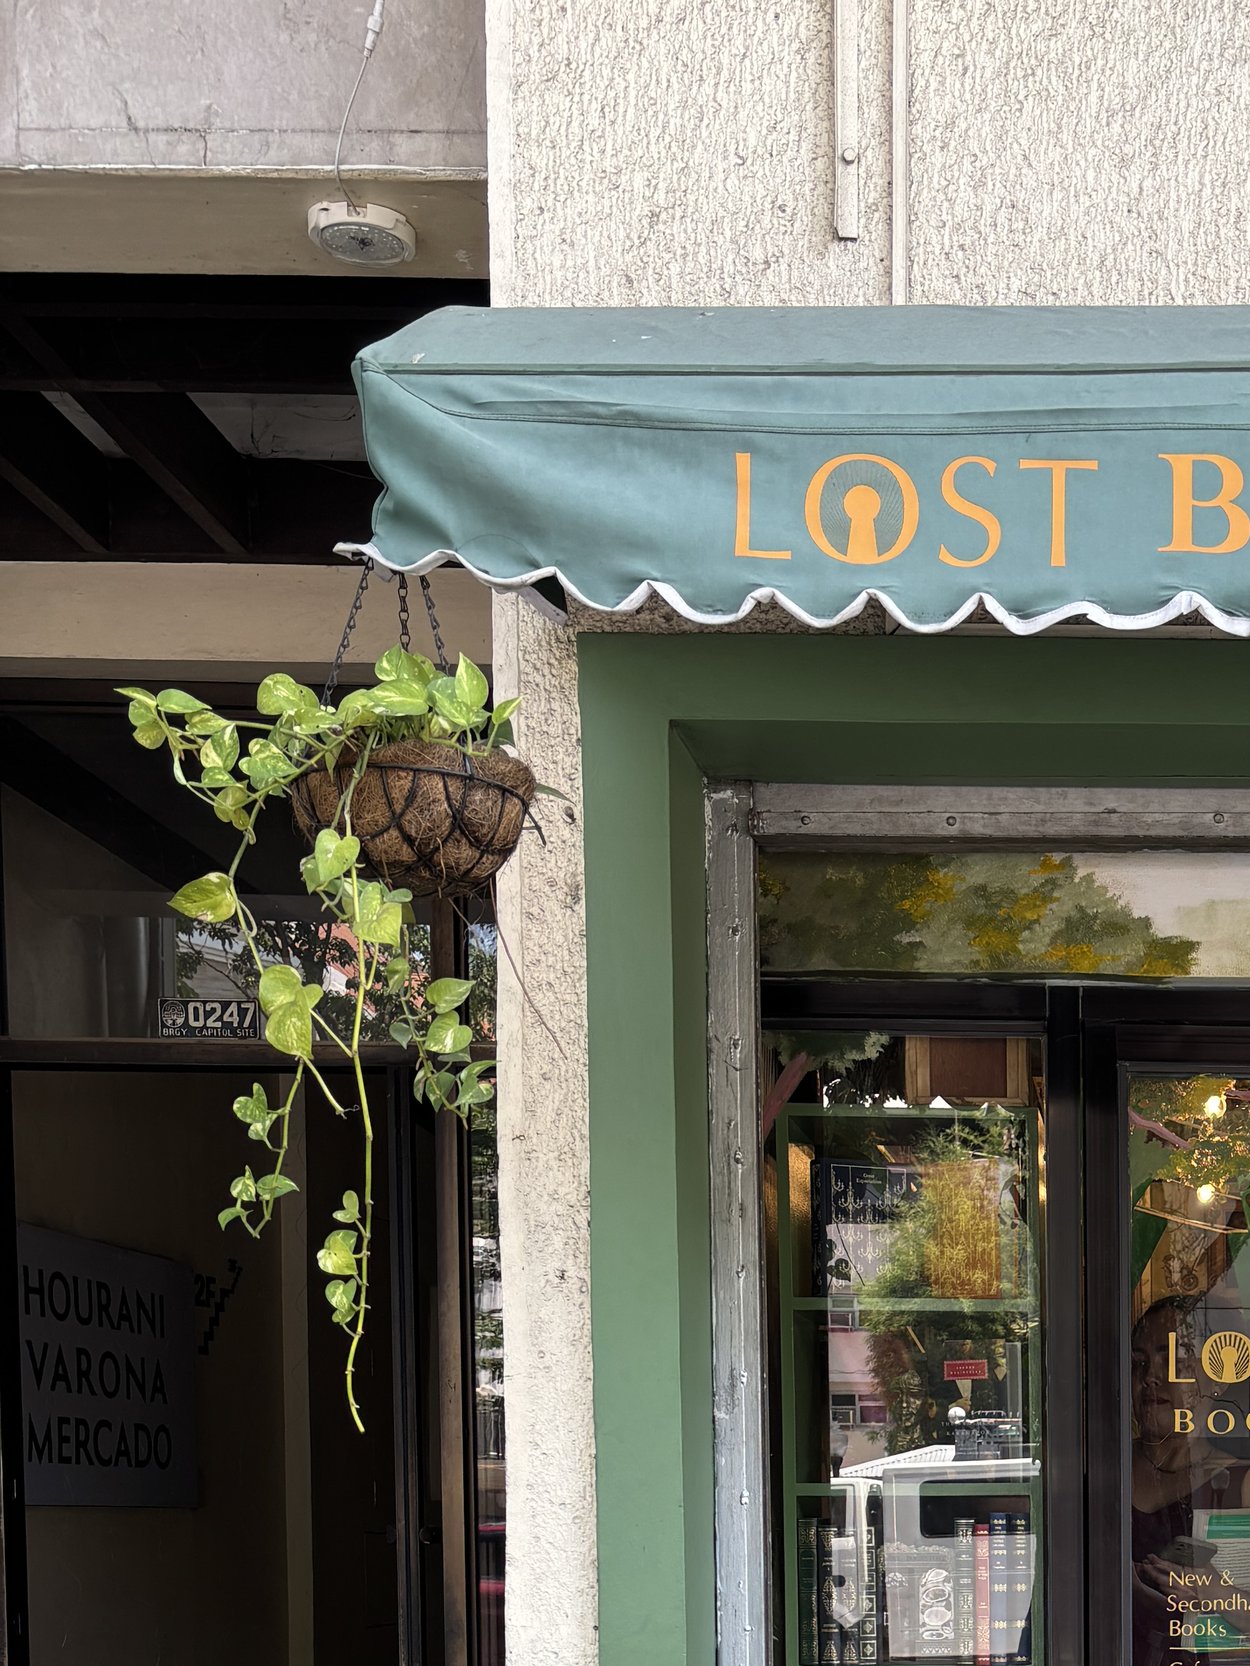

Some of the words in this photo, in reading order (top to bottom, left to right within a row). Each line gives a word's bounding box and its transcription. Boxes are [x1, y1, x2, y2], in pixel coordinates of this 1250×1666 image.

[735, 451, 1098, 570] LOST
[163, 1028, 188, 1037] BRGY
[196, 1028, 233, 1037] CAPITOL
[236, 1028, 255, 1037] SITE
[188, 1002, 255, 1028] 0247
[23, 1264, 165, 1339] HOURANI
[26, 1340, 168, 1405] VARONA
[28, 1412, 172, 1469] MERCADO
[1169, 1571, 1212, 1587] New
[1220, 1570, 1234, 1586] &
[1169, 1618, 1227, 1637] Books
